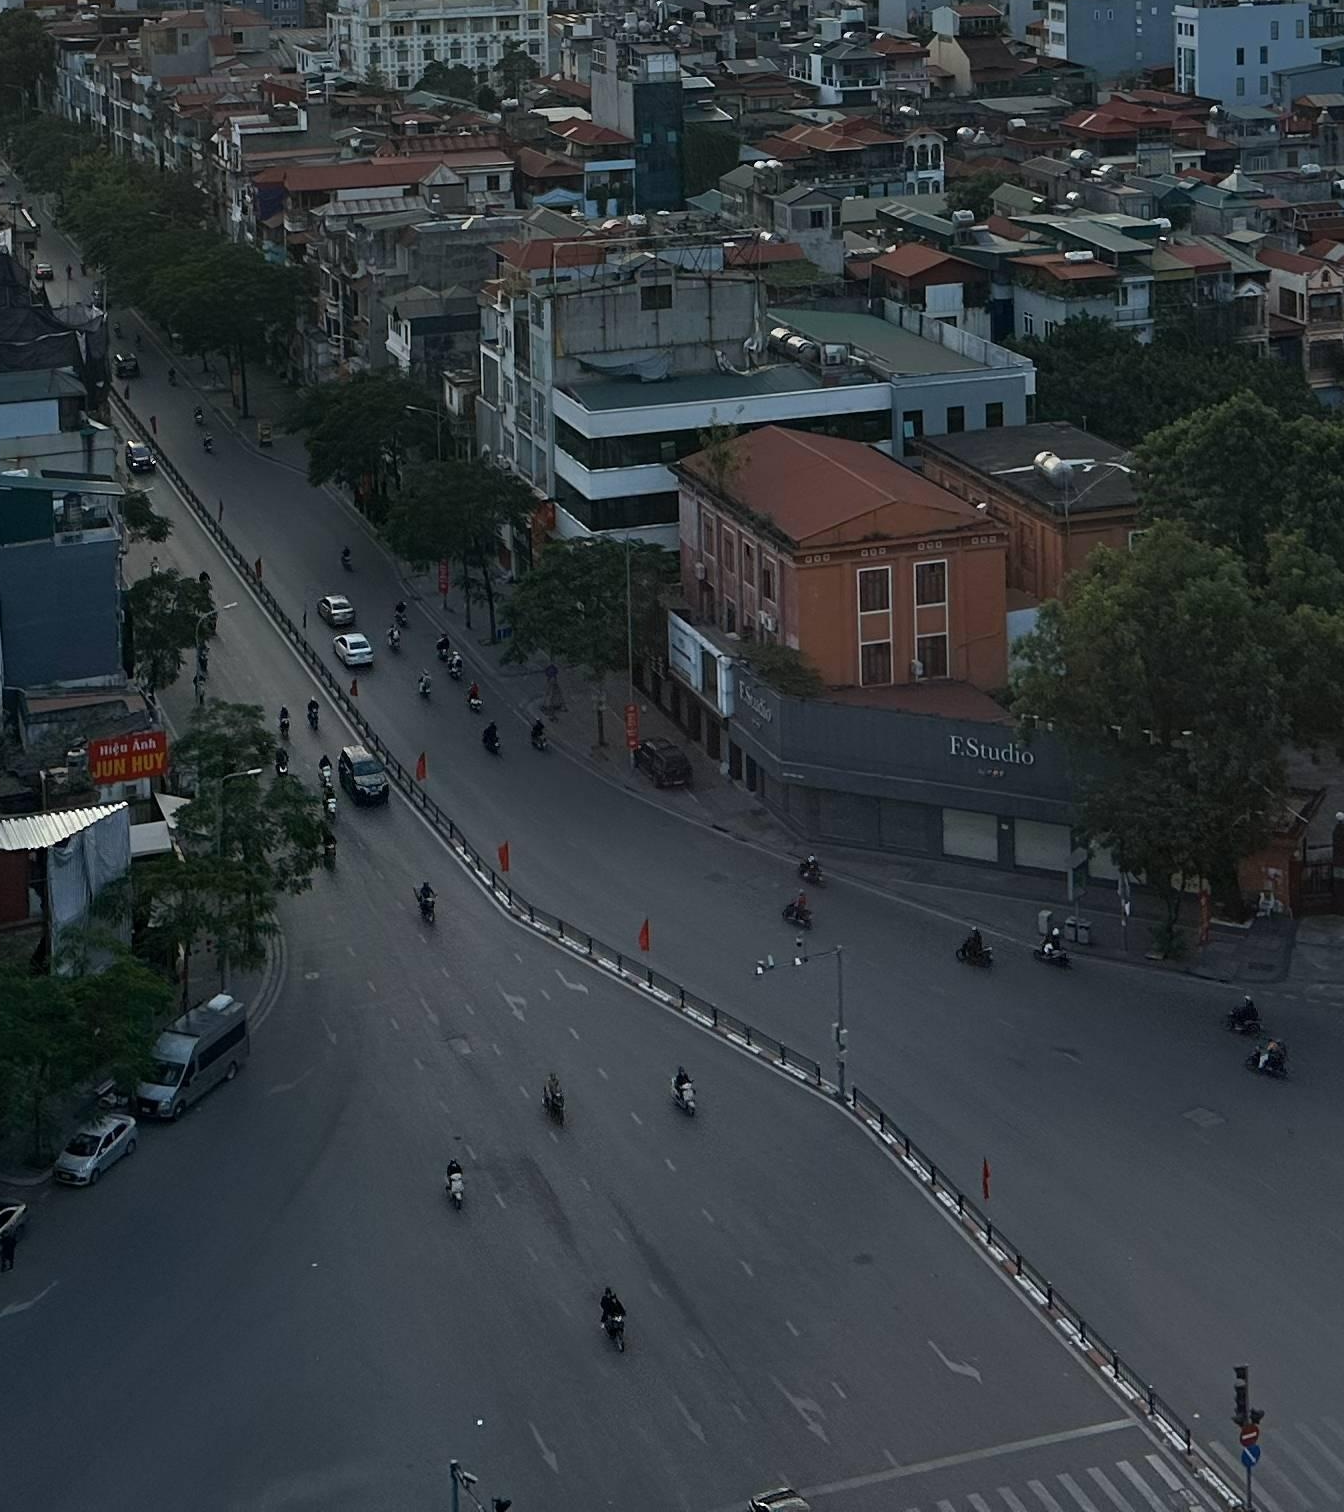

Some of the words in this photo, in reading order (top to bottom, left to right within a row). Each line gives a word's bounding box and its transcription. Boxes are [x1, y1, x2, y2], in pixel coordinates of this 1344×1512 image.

[949, 735, 1035, 766] F.Studio
[92, 758, 126, 779] JUN
[131, 752, 165, 774] HUY
